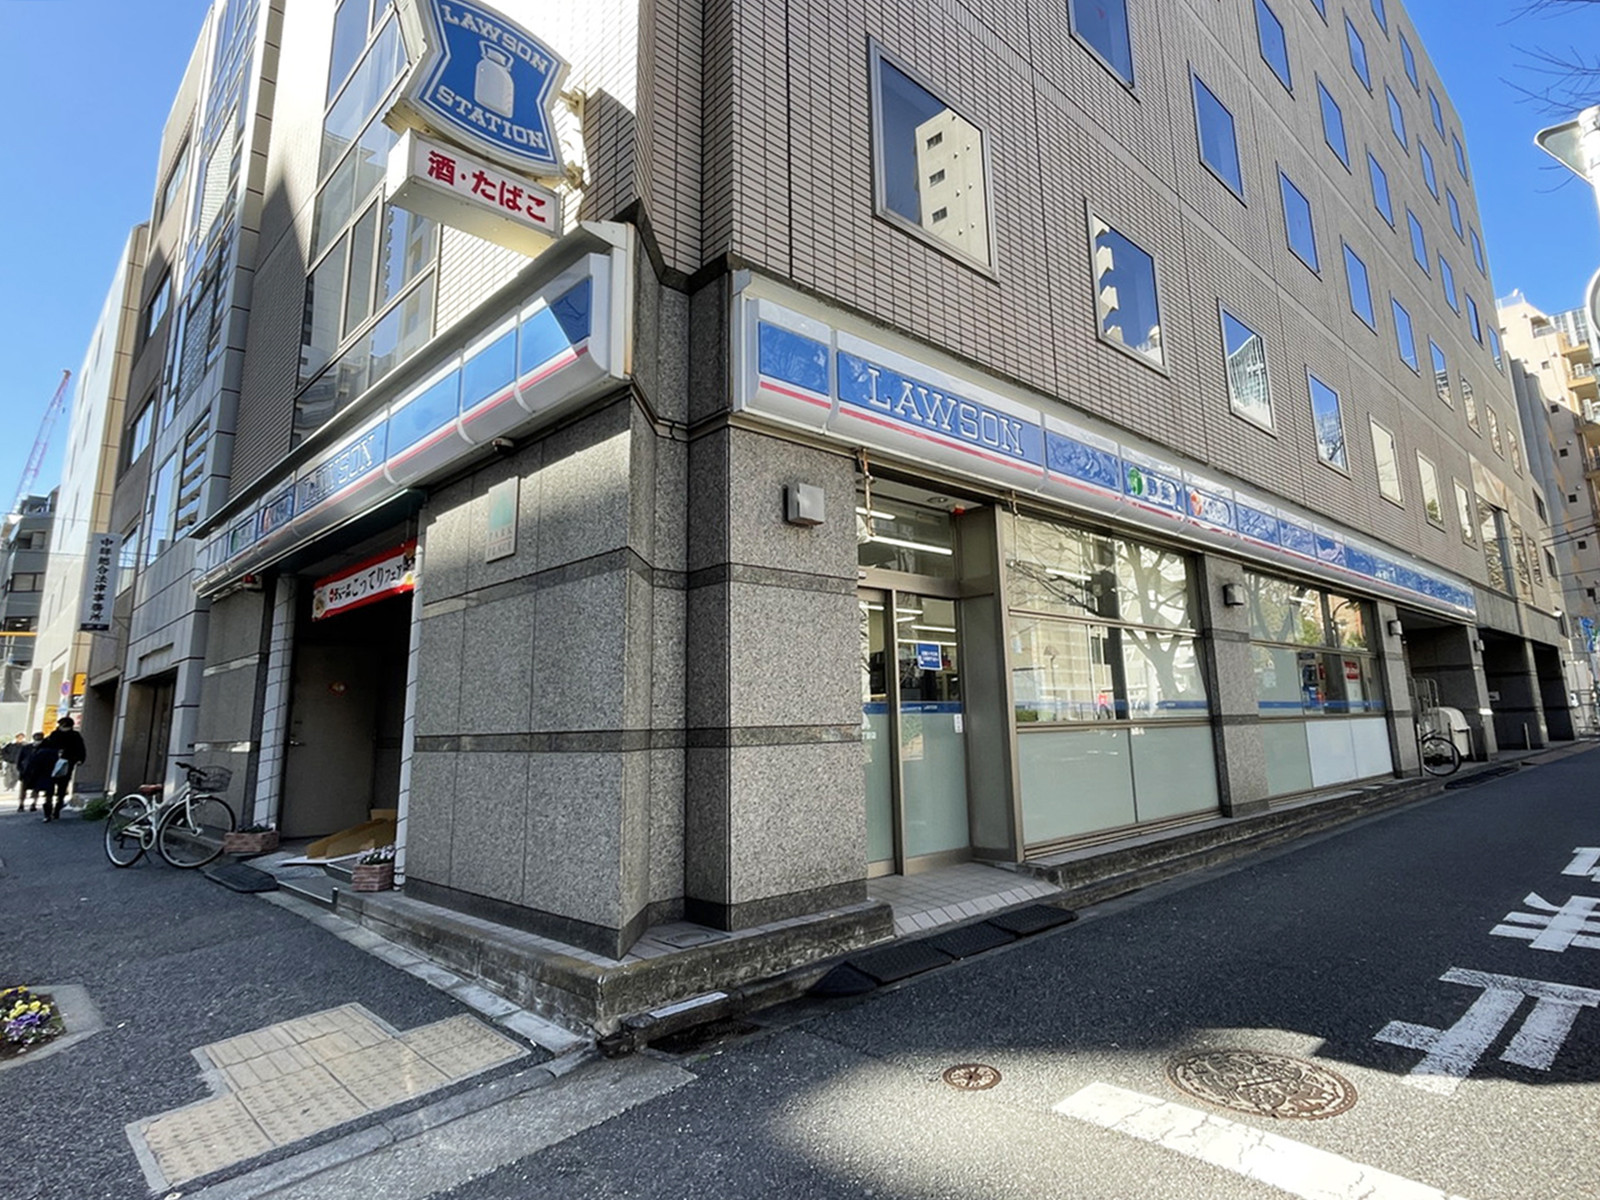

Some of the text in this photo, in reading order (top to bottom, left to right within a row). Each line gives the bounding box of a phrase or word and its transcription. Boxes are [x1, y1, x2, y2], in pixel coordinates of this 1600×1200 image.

[441, 4, 549, 76] LAWSON
[436, 85, 546, 150] STATION
[427, 150, 546, 223] 酒・たばこ
[867, 367, 1024, 456] LAWSON
